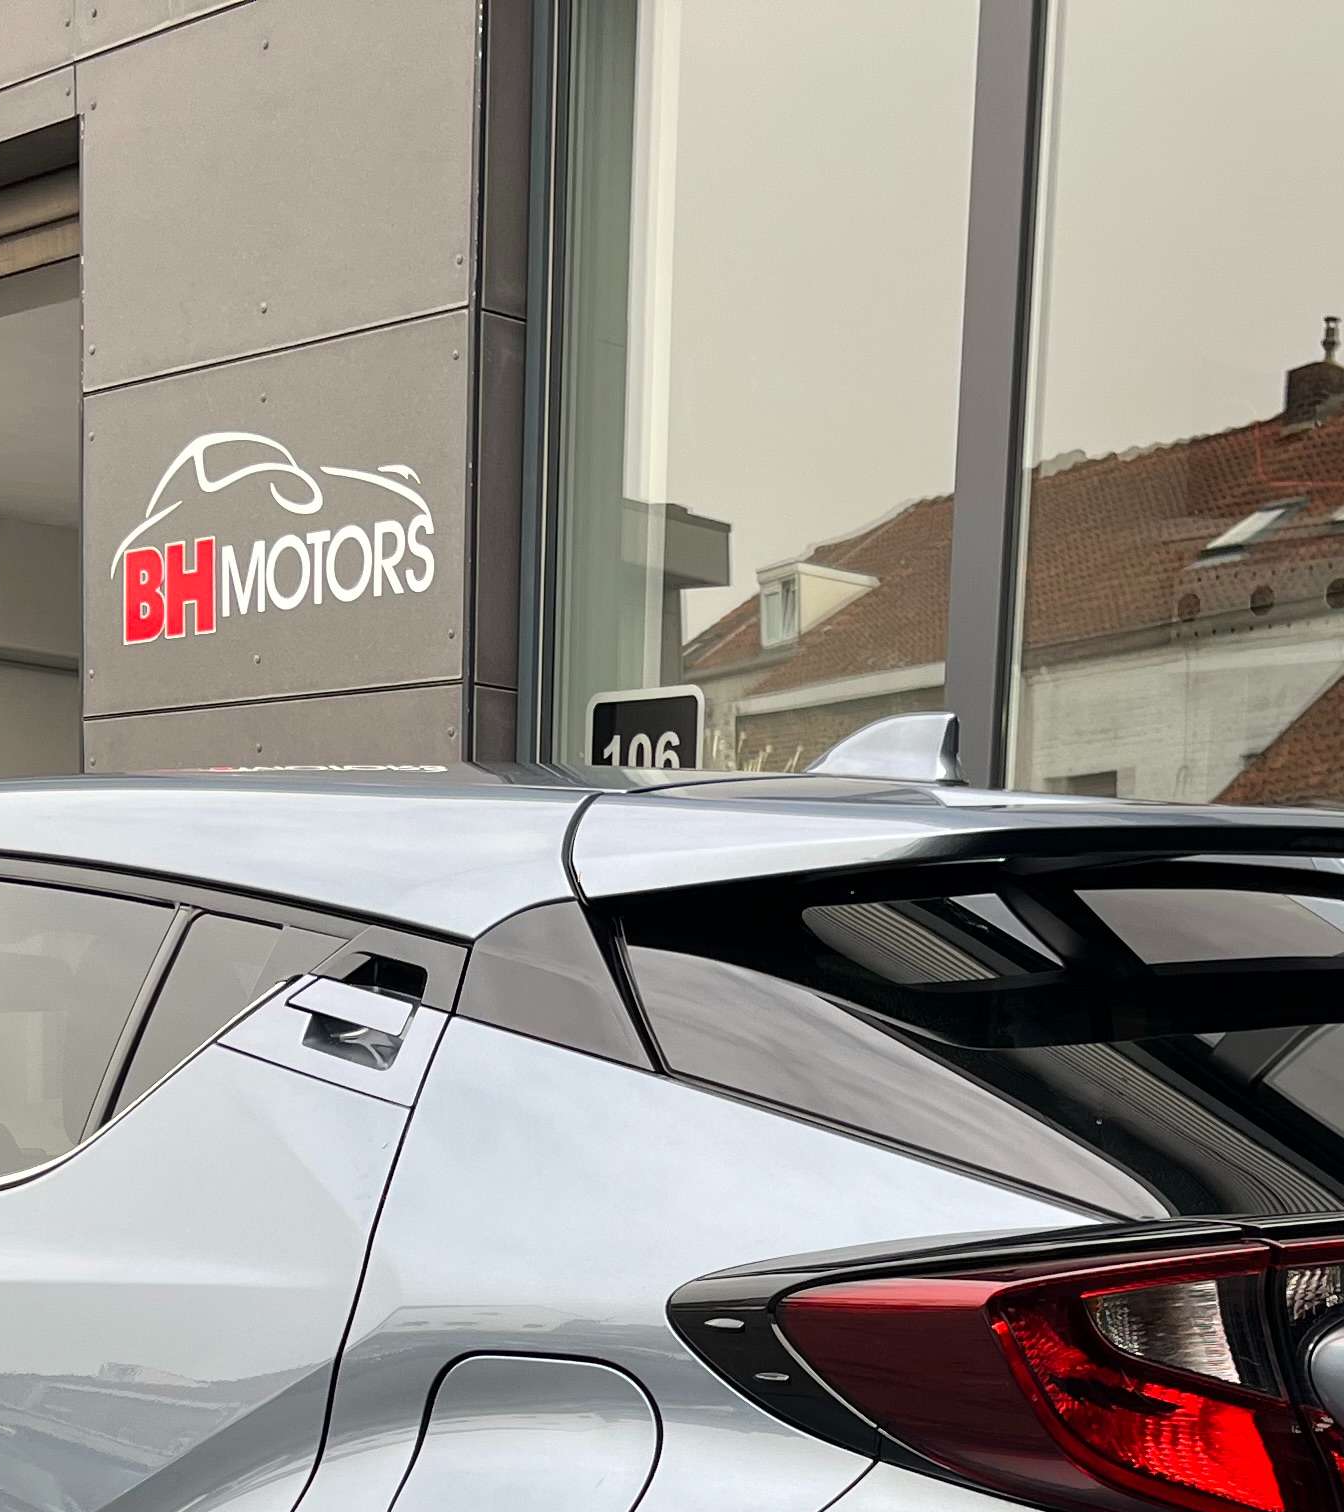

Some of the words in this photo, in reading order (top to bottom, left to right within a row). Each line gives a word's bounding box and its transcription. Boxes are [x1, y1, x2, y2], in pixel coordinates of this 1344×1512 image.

[122, 536, 217, 645] BH
[221, 513, 435, 617] MOTORS
[603, 731, 681, 768] 106
